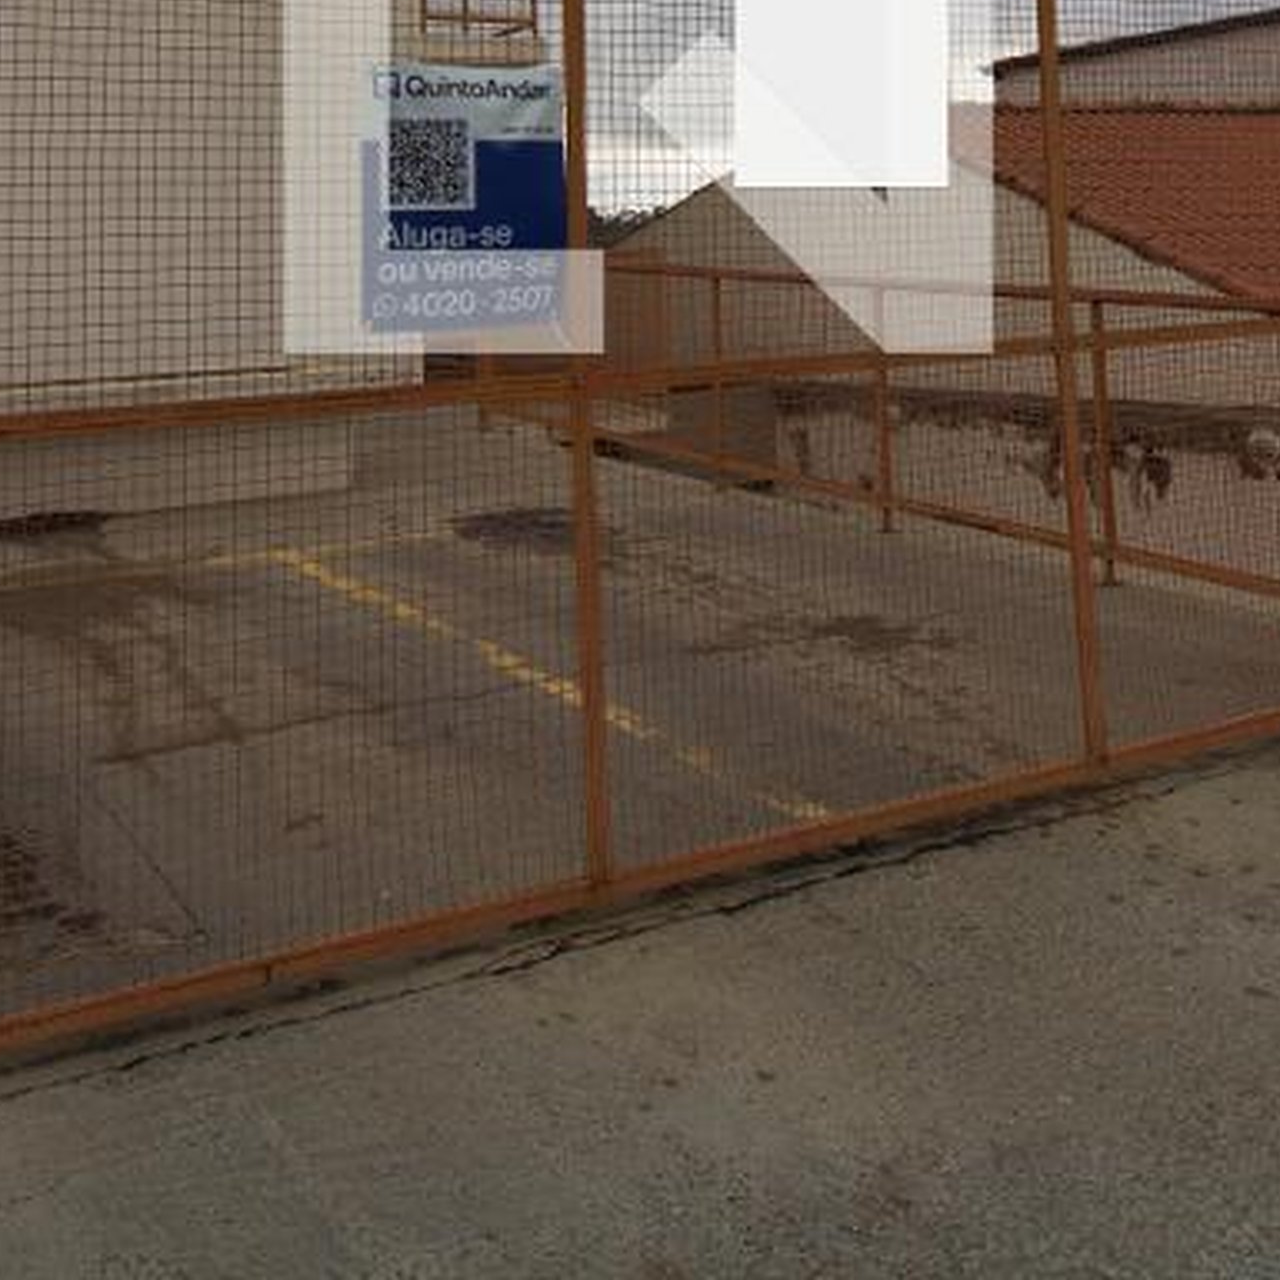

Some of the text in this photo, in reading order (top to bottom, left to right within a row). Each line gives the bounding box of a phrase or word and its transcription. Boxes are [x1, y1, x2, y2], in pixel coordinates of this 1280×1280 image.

[404, 74, 551, 99] QuintoAndar
[377, 222, 514, 254] Aluga-se
[377, 261, 418, 284] ou
